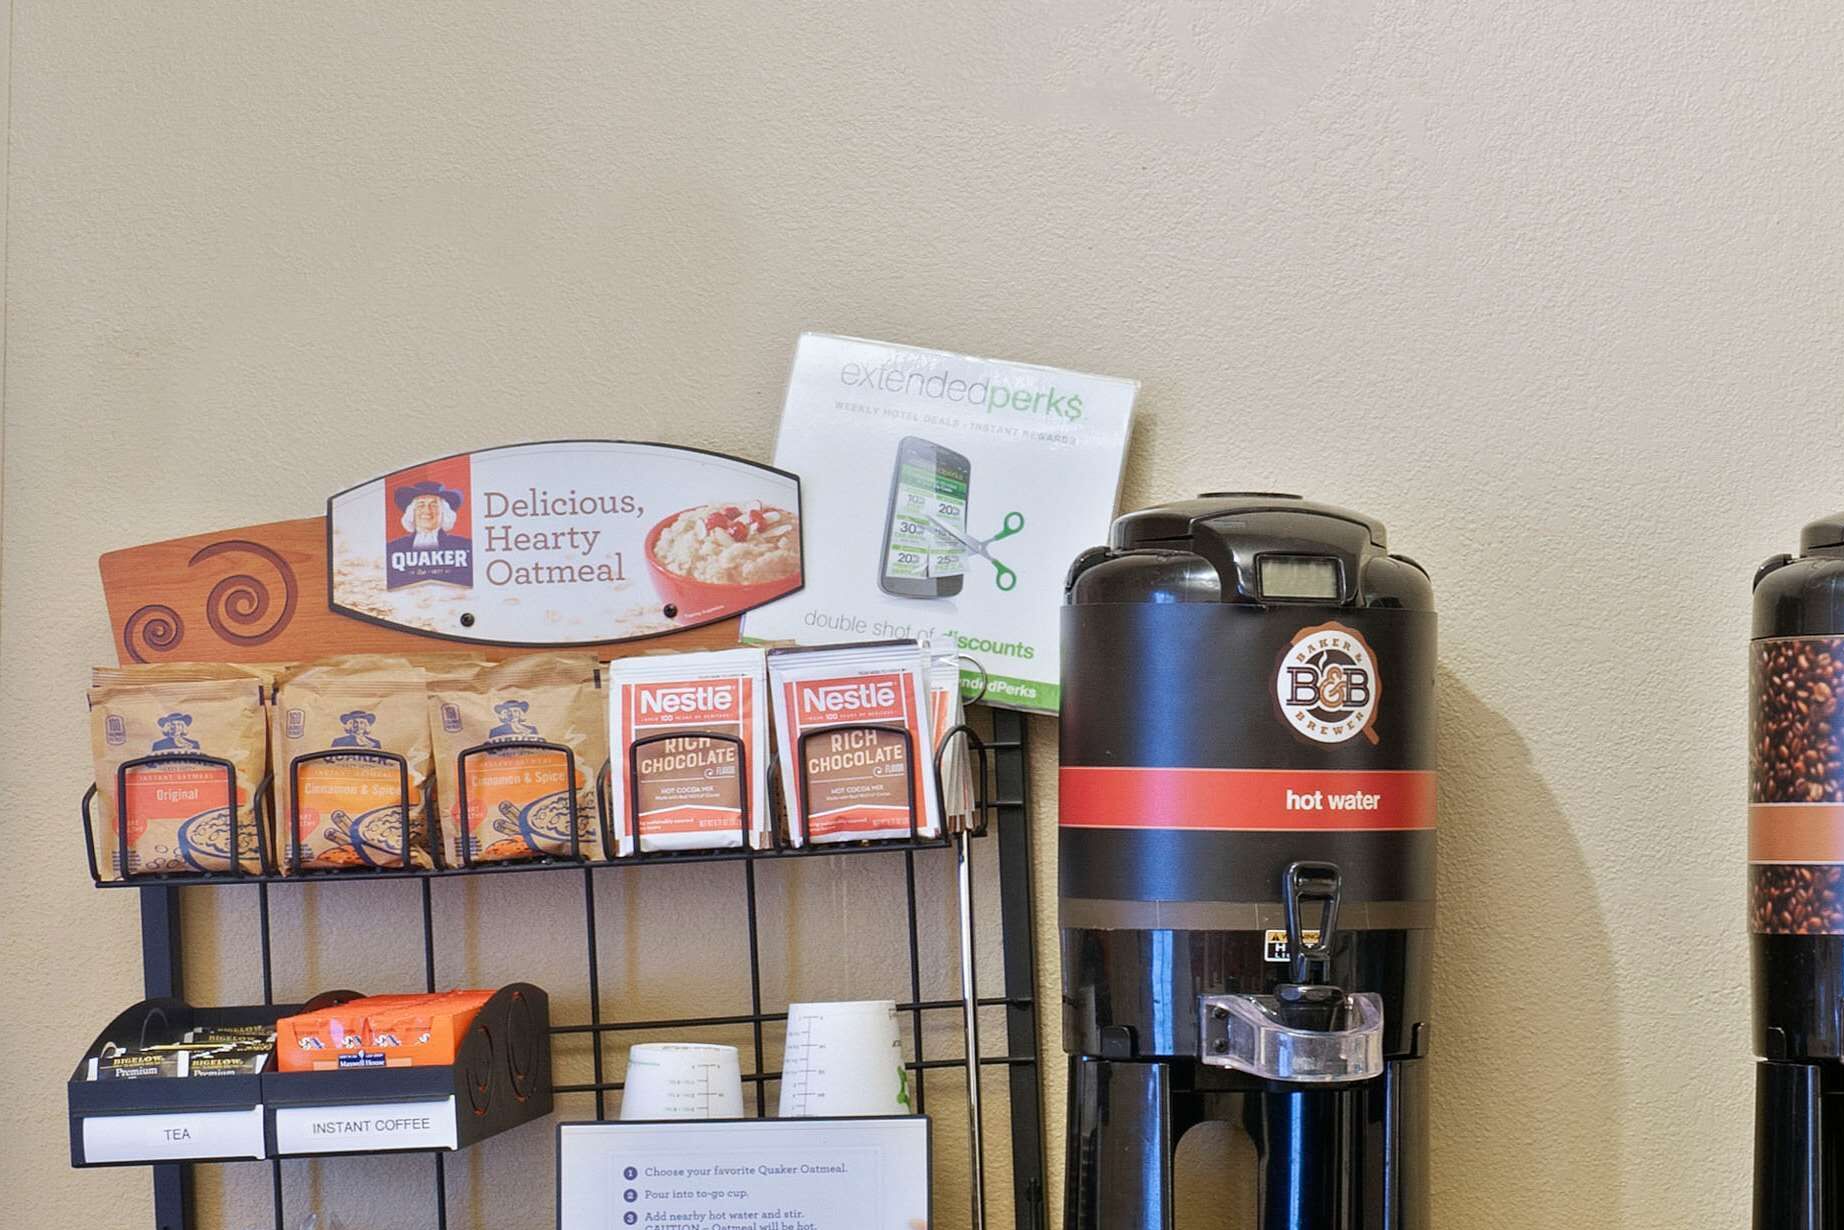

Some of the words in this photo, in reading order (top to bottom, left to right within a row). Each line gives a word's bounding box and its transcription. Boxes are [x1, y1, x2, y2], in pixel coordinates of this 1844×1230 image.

[883, 409, 920, 423] HOTEL
[484, 488, 644, 519] Delicious,
[485, 525, 600, 556] Hearty
[392, 550, 468, 571] QUAKER
[486, 553, 625, 585] Oatmeal
[804, 610, 868, 635] double
[871, 619, 911, 639] shot
[1295, 638, 1352, 663] BAKER
[803, 682, 895, 713] Nestlé
[1286, 666, 1370, 708] B&B
[640, 686, 733, 714] Nestlé
[1295, 711, 1364, 736] BREWER
[831, 730, 877, 752] RICH
[641, 748, 735, 774] CHOCOLATE
[809, 745, 904, 774] CHOCOLATE
[156, 788, 198, 802] Original
[1286, 789, 1323, 810] hot
[1328, 791, 1381, 810] water
[115, 1067, 158, 1077] Premium
[164, 1128, 191, 1142] TEA
[312, 1119, 371, 1133] INSTANT
[375, 1117, 430, 1132] COFFEE
[644, 1167, 685, 1177] Choose
[687, 1168, 711, 1178] your
[714, 1166, 756, 1176] favorite
[758, 1164, 797, 1176] Quaker
[800, 1163, 848, 1174] Oatmeal.
[644, 1190, 671, 1199] Pour
[672, 1189, 695, 1198] into
[696, 1189, 725, 1199] to-go
[644, 1211, 667, 1221] Add
[669, 1210, 706, 1222] nearby
[709, 1210, 726, 1220] hot
[728, 1211, 759, 1220] water
[761, 1209, 781, 1219] and
[784, 1209, 805, 1219] stir.
[782, 1222, 794, 1230] be
